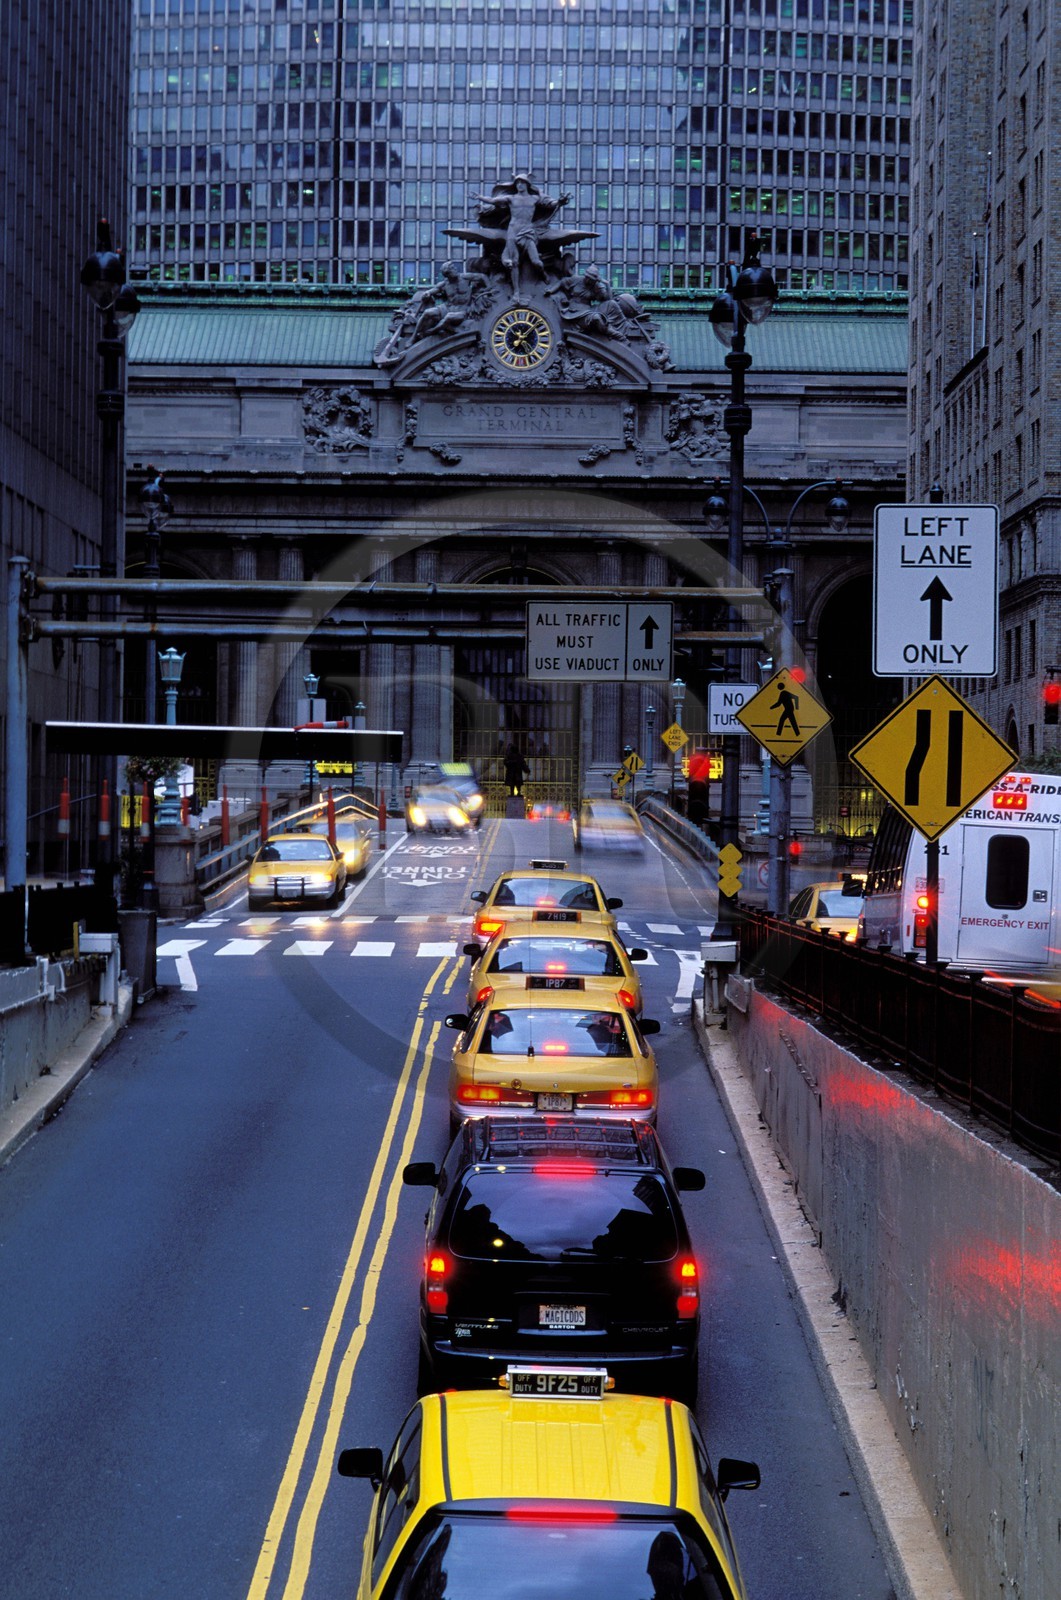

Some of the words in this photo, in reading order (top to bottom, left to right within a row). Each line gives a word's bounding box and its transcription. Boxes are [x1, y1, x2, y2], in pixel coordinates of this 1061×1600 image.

[443, 405, 504, 418] GRAND
[516, 406, 597, 419] CENTRAL
[477, 419, 564, 431] TERMINAL
[904, 517, 969, 537] LEFT
[901, 545, 972, 564] LANE
[536, 613, 560, 626] ALL
[565, 613, 621, 626] TRAFFIC
[556, 635, 594, 648] MUST
[903, 644, 969, 664] ONLY
[535, 657, 560, 670] USE
[566, 658, 620, 671] VIADUCT
[632, 658, 665, 671] ONLY
[723, 693, 744, 707] NO
[713, 713, 740, 726] TUR
[991, 782, 1061, 796] SS-A-RIDE
[961, 808, 1013, 821] ERICAN
[1014, 811, 1061, 824] TRANS
[547, 912, 567, 921] 7H19
[961, 916, 1025, 929] EMERGENCY
[1027, 921, 1050, 930] EXIT
[517, 1374, 531, 1382] OFF
[536, 1374, 578, 1393] 9F25
[583, 1376, 597, 1384] OFF
[515, 1383, 532, 1393] DUTY
[581, 1385, 598, 1394] DUTY
